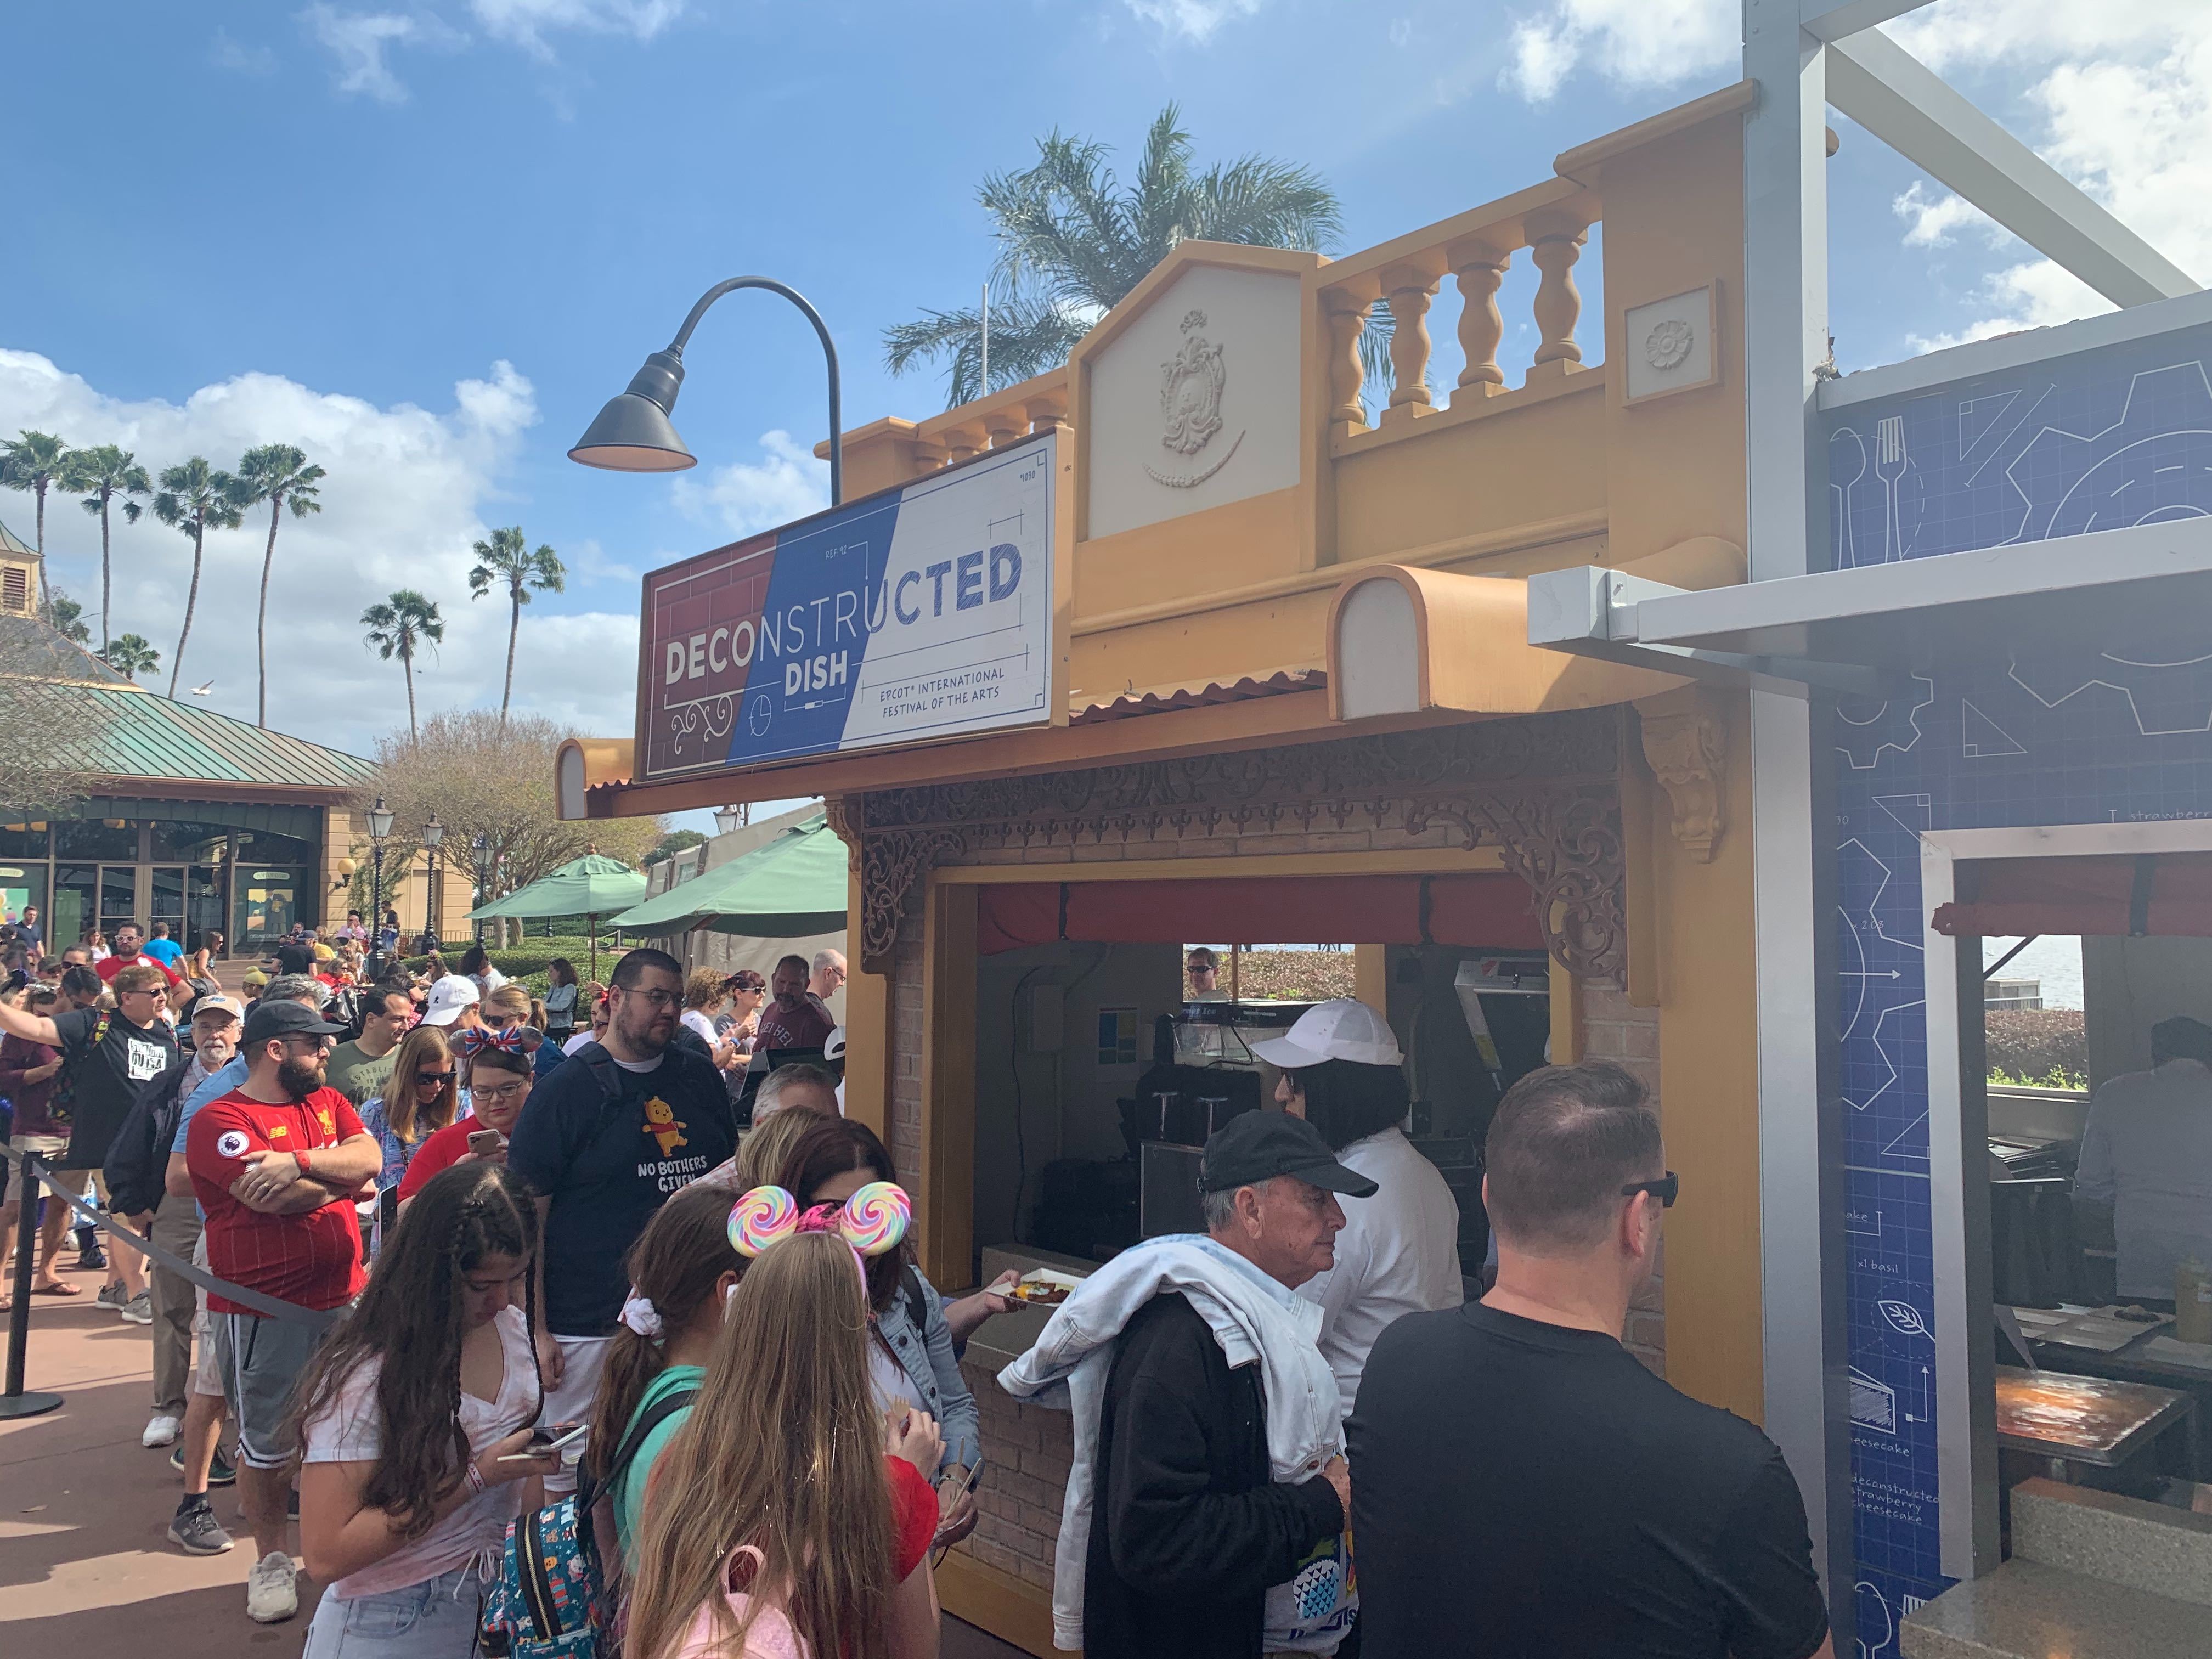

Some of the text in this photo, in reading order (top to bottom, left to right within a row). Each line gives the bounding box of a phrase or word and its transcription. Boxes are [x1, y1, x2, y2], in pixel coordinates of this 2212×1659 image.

[665, 543, 1022, 685] DECONSTRUCTED
[785, 650, 847, 696] DISH
[918, 668, 1005, 695] INTERNATIONAL
[883, 686, 1000, 718] FESTIVAL OF THE ARTS
[772, 1024, 793, 1047] HEI
[637, 1155, 707, 1177] NO BOTHERS
[1871, 1259, 1899, 1273] basil
